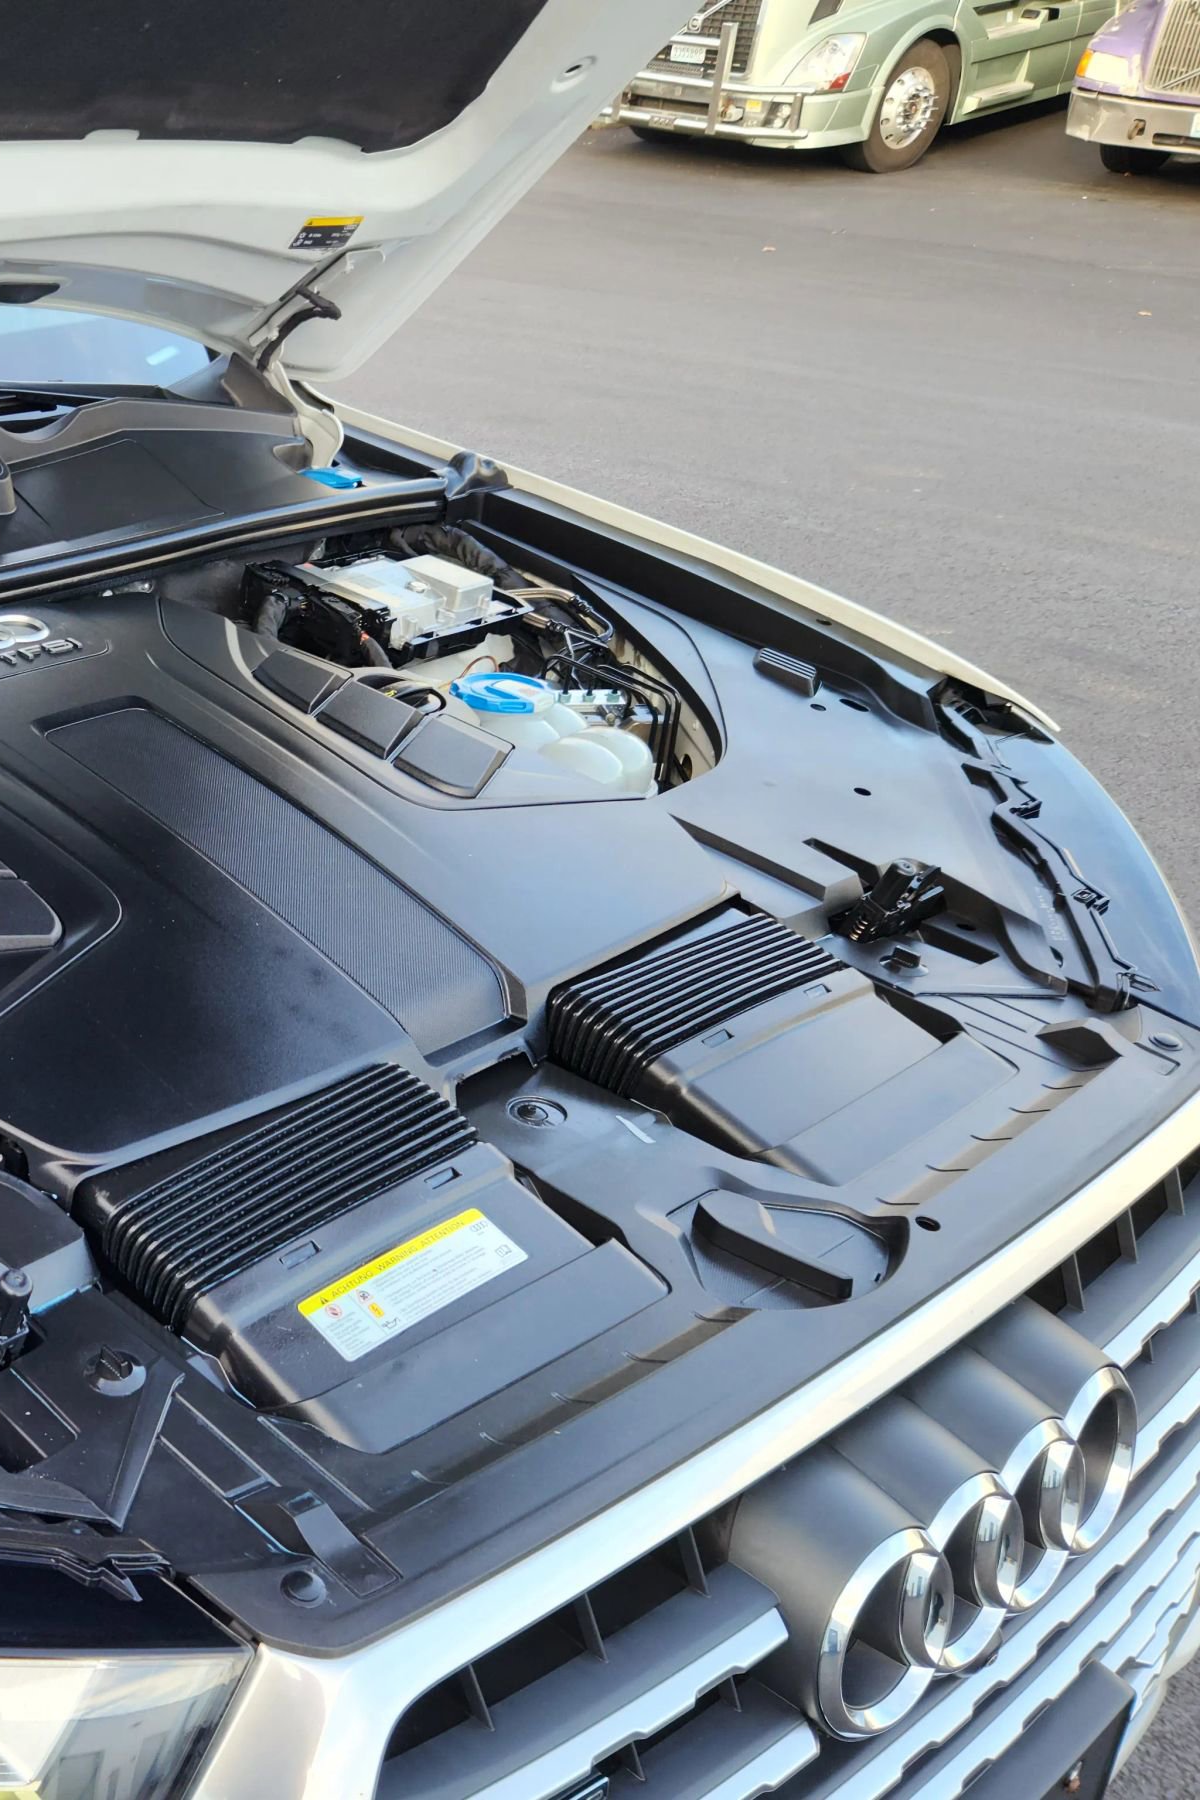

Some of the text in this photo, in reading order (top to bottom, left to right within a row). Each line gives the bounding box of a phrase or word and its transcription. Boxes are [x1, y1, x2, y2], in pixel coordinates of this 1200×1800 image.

[331, 1270, 374, 1298] ACHTUNG
[376, 1244, 418, 1271] WARNING
[420, 1220, 465, 1247] ATTENTION
